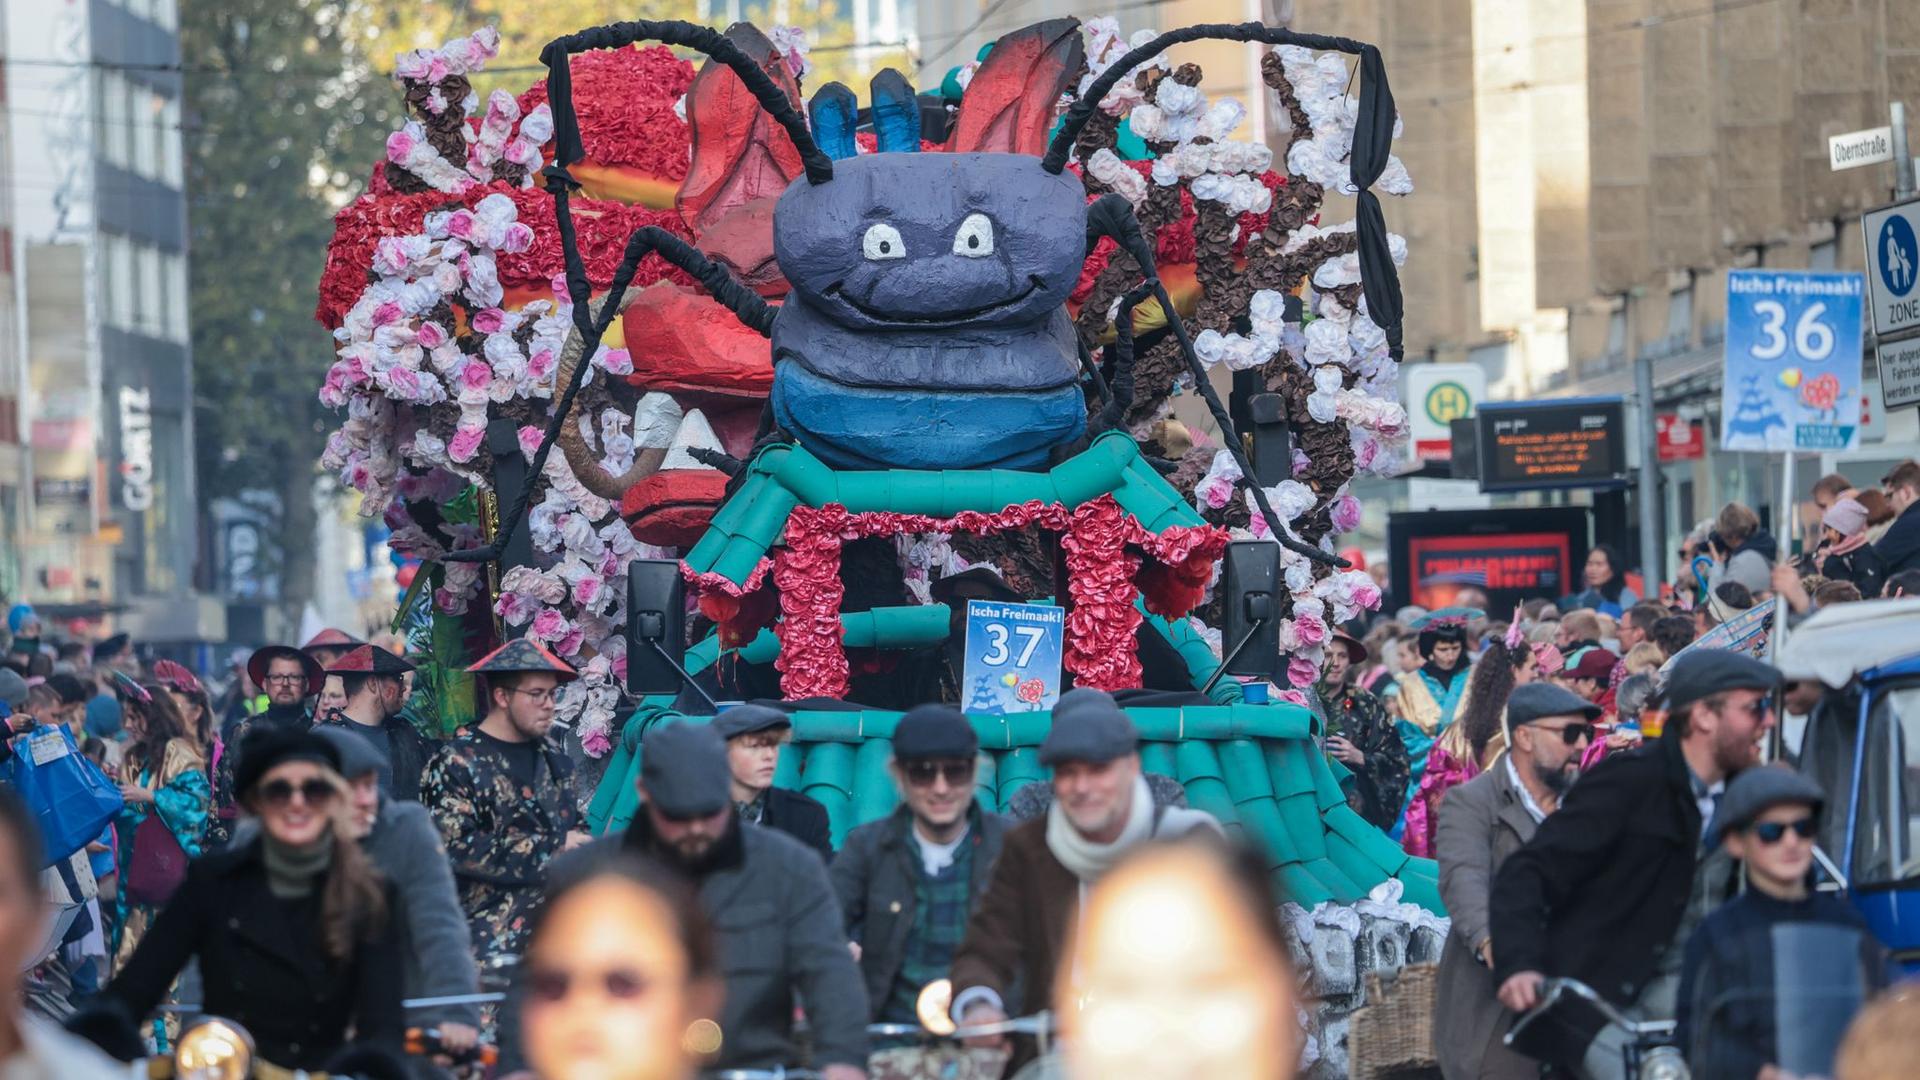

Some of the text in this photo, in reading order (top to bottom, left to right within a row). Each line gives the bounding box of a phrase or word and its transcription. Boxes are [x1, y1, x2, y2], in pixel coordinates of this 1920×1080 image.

[1834, 135, 1887, 163] Obernstraße
[1730, 275, 1861, 295] Ischa Freimaak!
[1888, 300, 1920, 324] ZONE
[1750, 300, 1834, 361] 36
[970, 605, 1061, 623] Ischa Freimaak!
[982, 623, 1047, 668] 37
